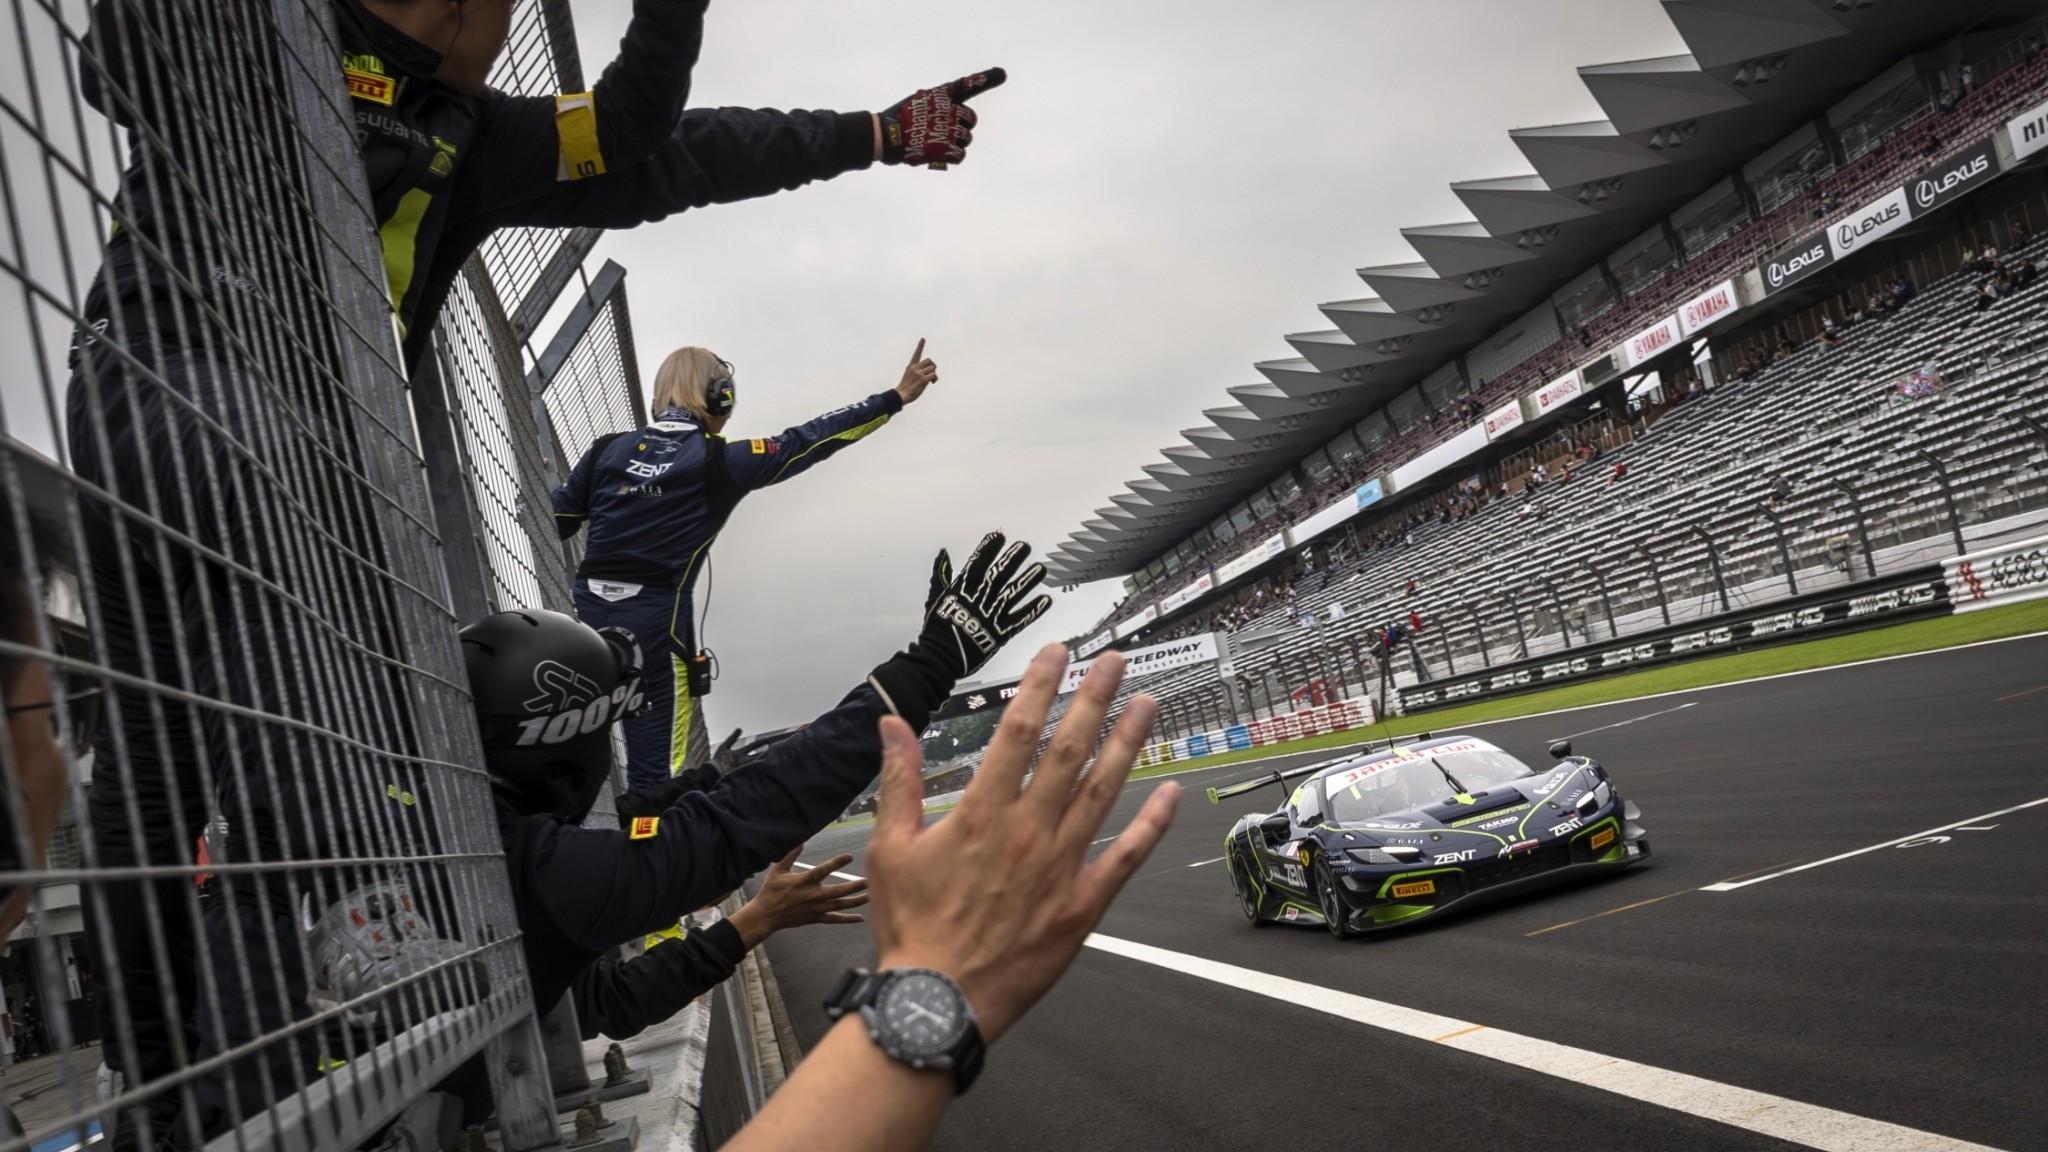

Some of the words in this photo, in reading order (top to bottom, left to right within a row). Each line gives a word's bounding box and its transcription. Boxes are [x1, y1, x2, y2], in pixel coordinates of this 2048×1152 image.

[1934, 155, 1988, 194] LEXUS
[1853, 203, 1901, 238] LEXUS
[1781, 245, 1825, 276] LEXUS
[1695, 289, 1730, 322] YAMAHA
[1642, 324, 1672, 355] YAMAHA
[625, 459, 675, 478] ZENT
[937, 595, 996, 654] freem
[1125, 642, 1202, 665] PEEDWAY
[515, 676, 644, 746] 100%
[1548, 817, 1583, 837] ZENT
[1434, 849, 1476, 865] ZENT
